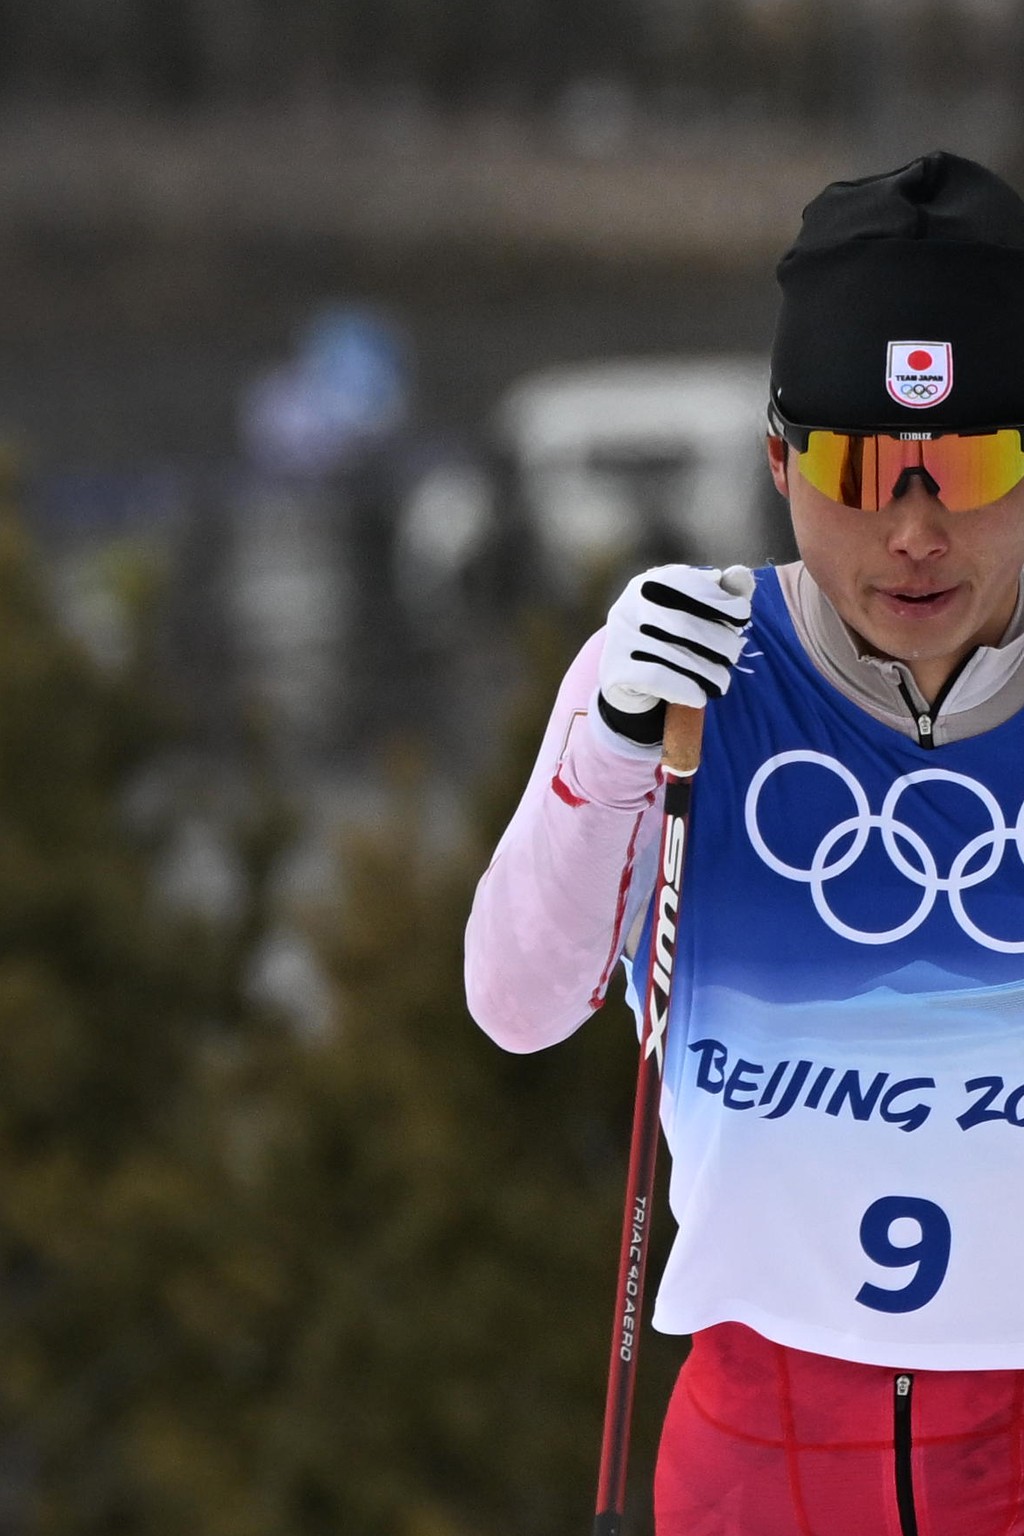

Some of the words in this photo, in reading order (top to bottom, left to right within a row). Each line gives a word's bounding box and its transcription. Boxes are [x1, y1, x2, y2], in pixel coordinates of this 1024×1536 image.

[645, 814, 685, 1081] SWIX
[688, 1038, 935, 1133] BEIJING
[629, 1196, 646, 1262] TRIAC
[855, 1195, 952, 1314] 9
[619, 1297, 636, 1363] AERO
